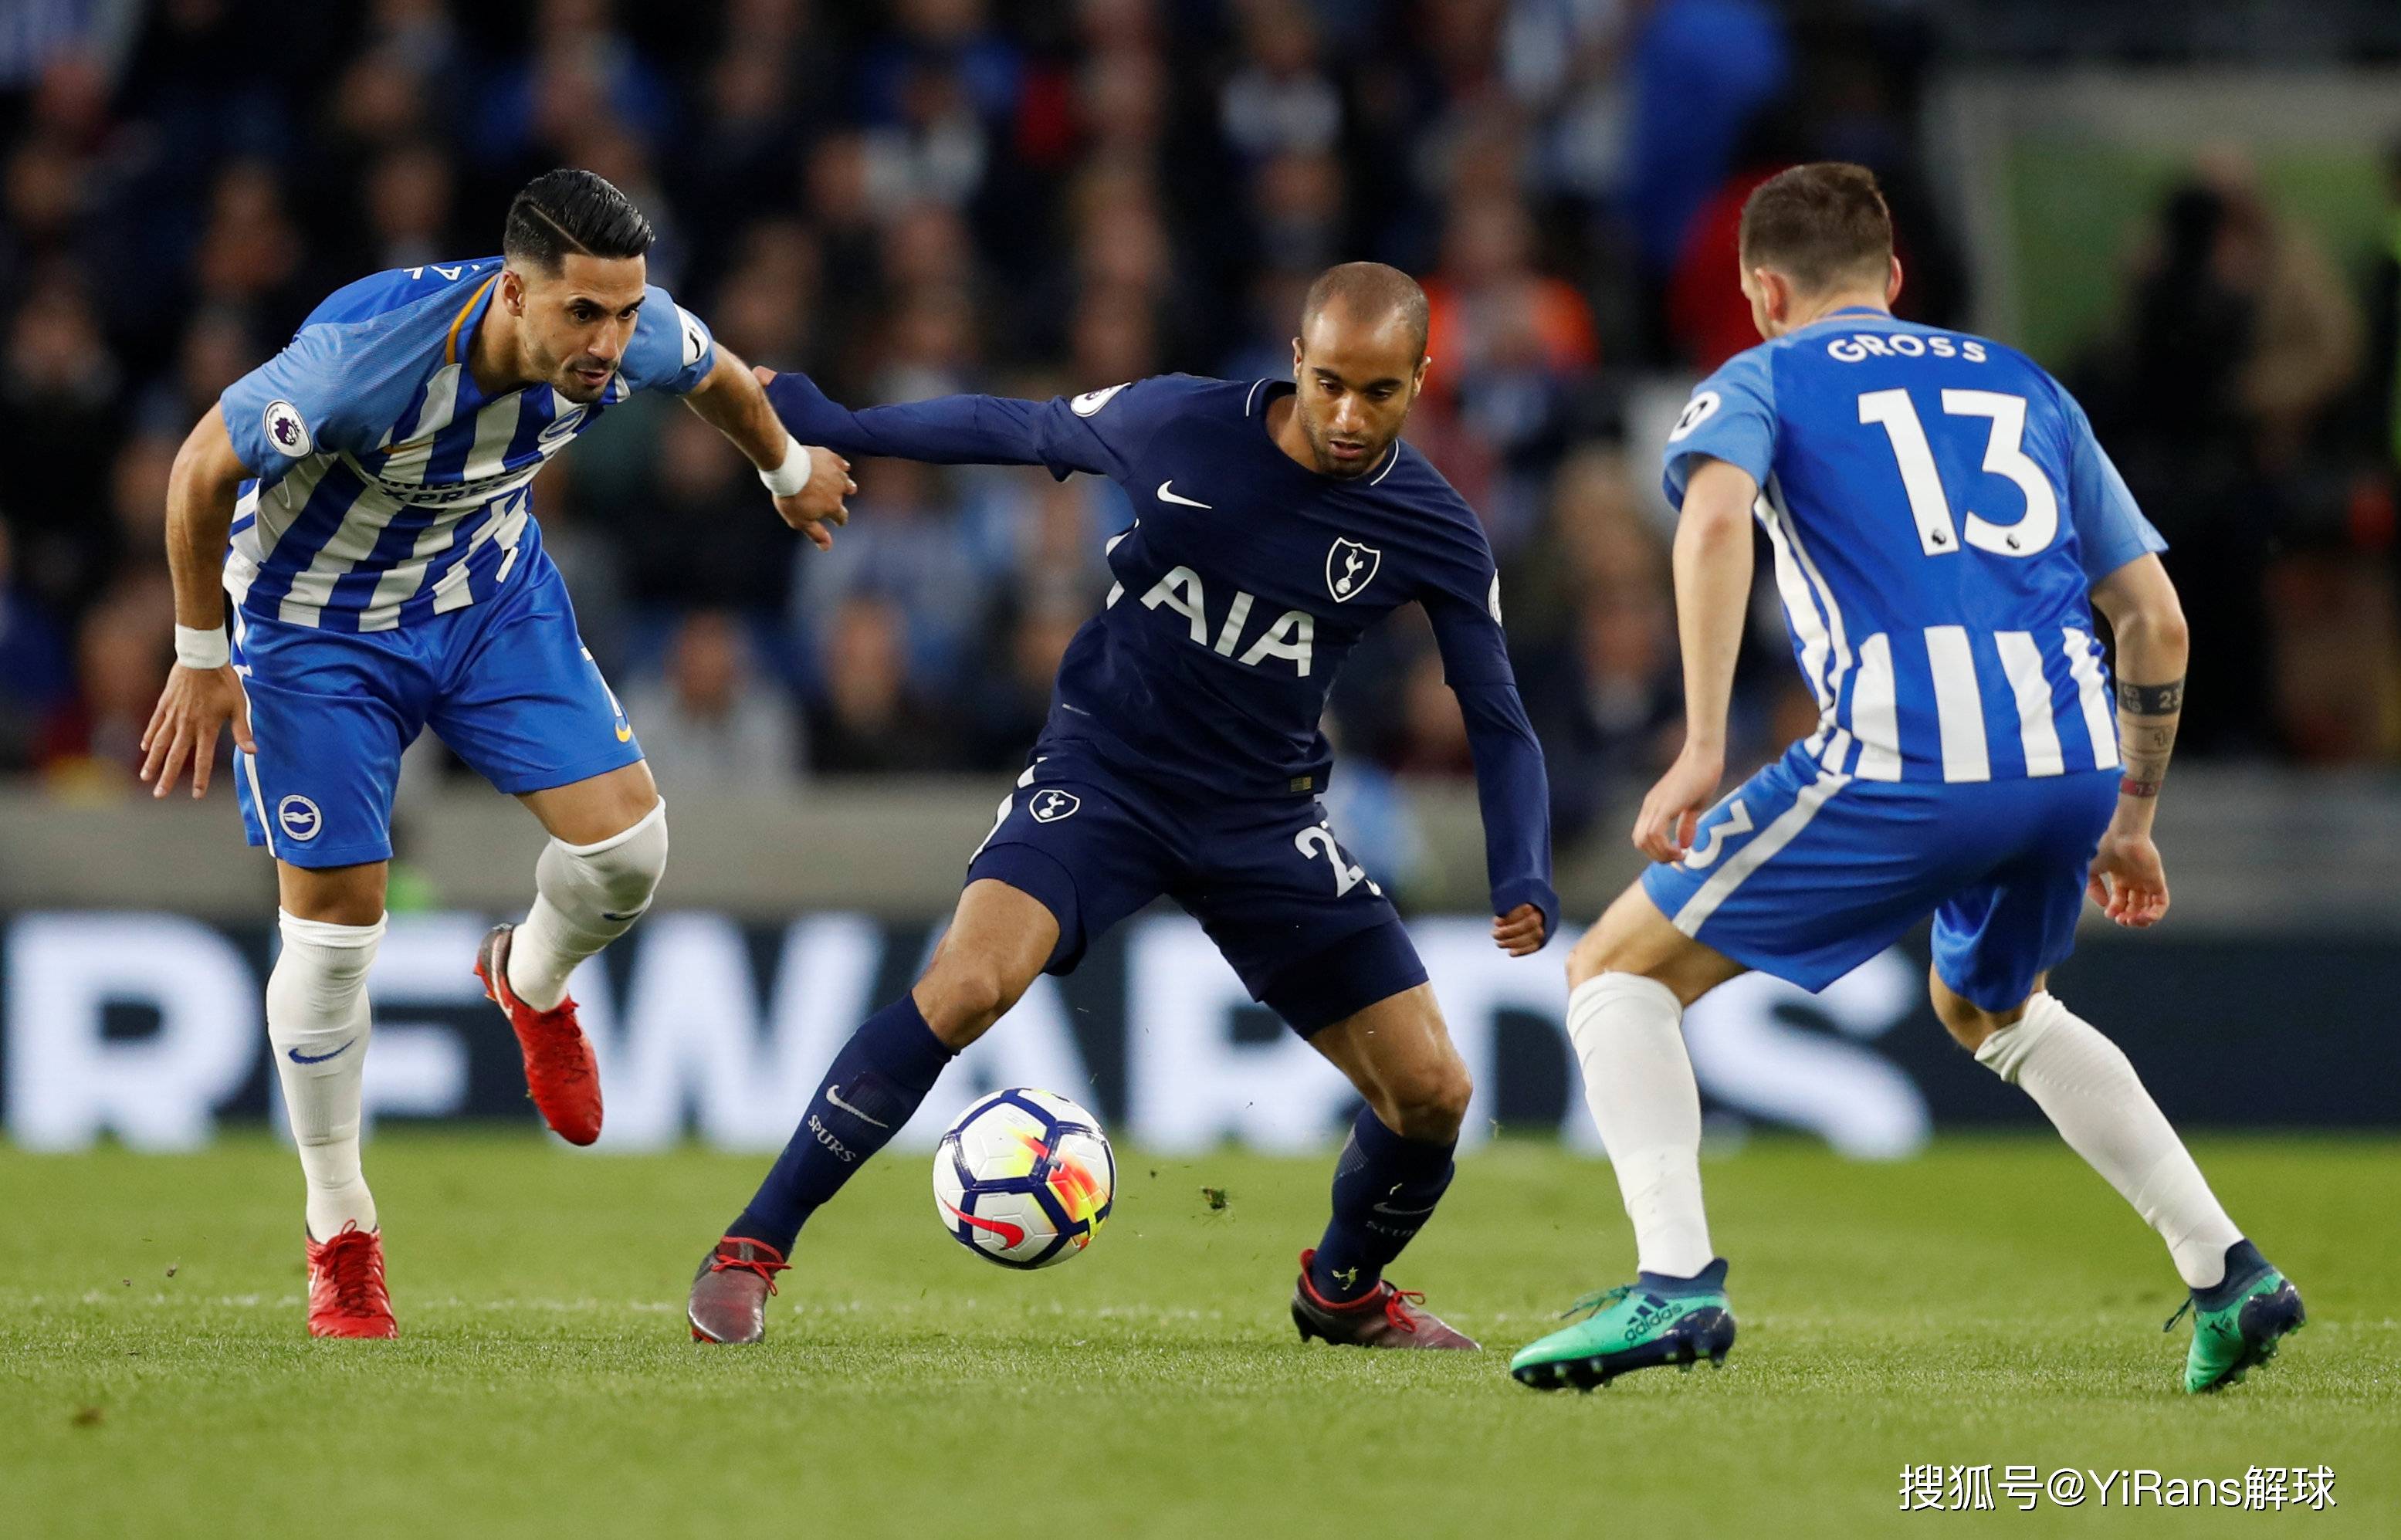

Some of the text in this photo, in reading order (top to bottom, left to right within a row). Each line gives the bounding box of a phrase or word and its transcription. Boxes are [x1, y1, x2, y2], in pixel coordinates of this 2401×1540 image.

[1827, 333, 1987, 364] GROSS
[1857, 388, 2059, 557] 13
[1141, 565, 1315, 677] AIA
[1295, 820, 1366, 898] 2
[808, 1114, 856, 1162] SPURS
[1624, 1302, 1682, 1342] adidas
